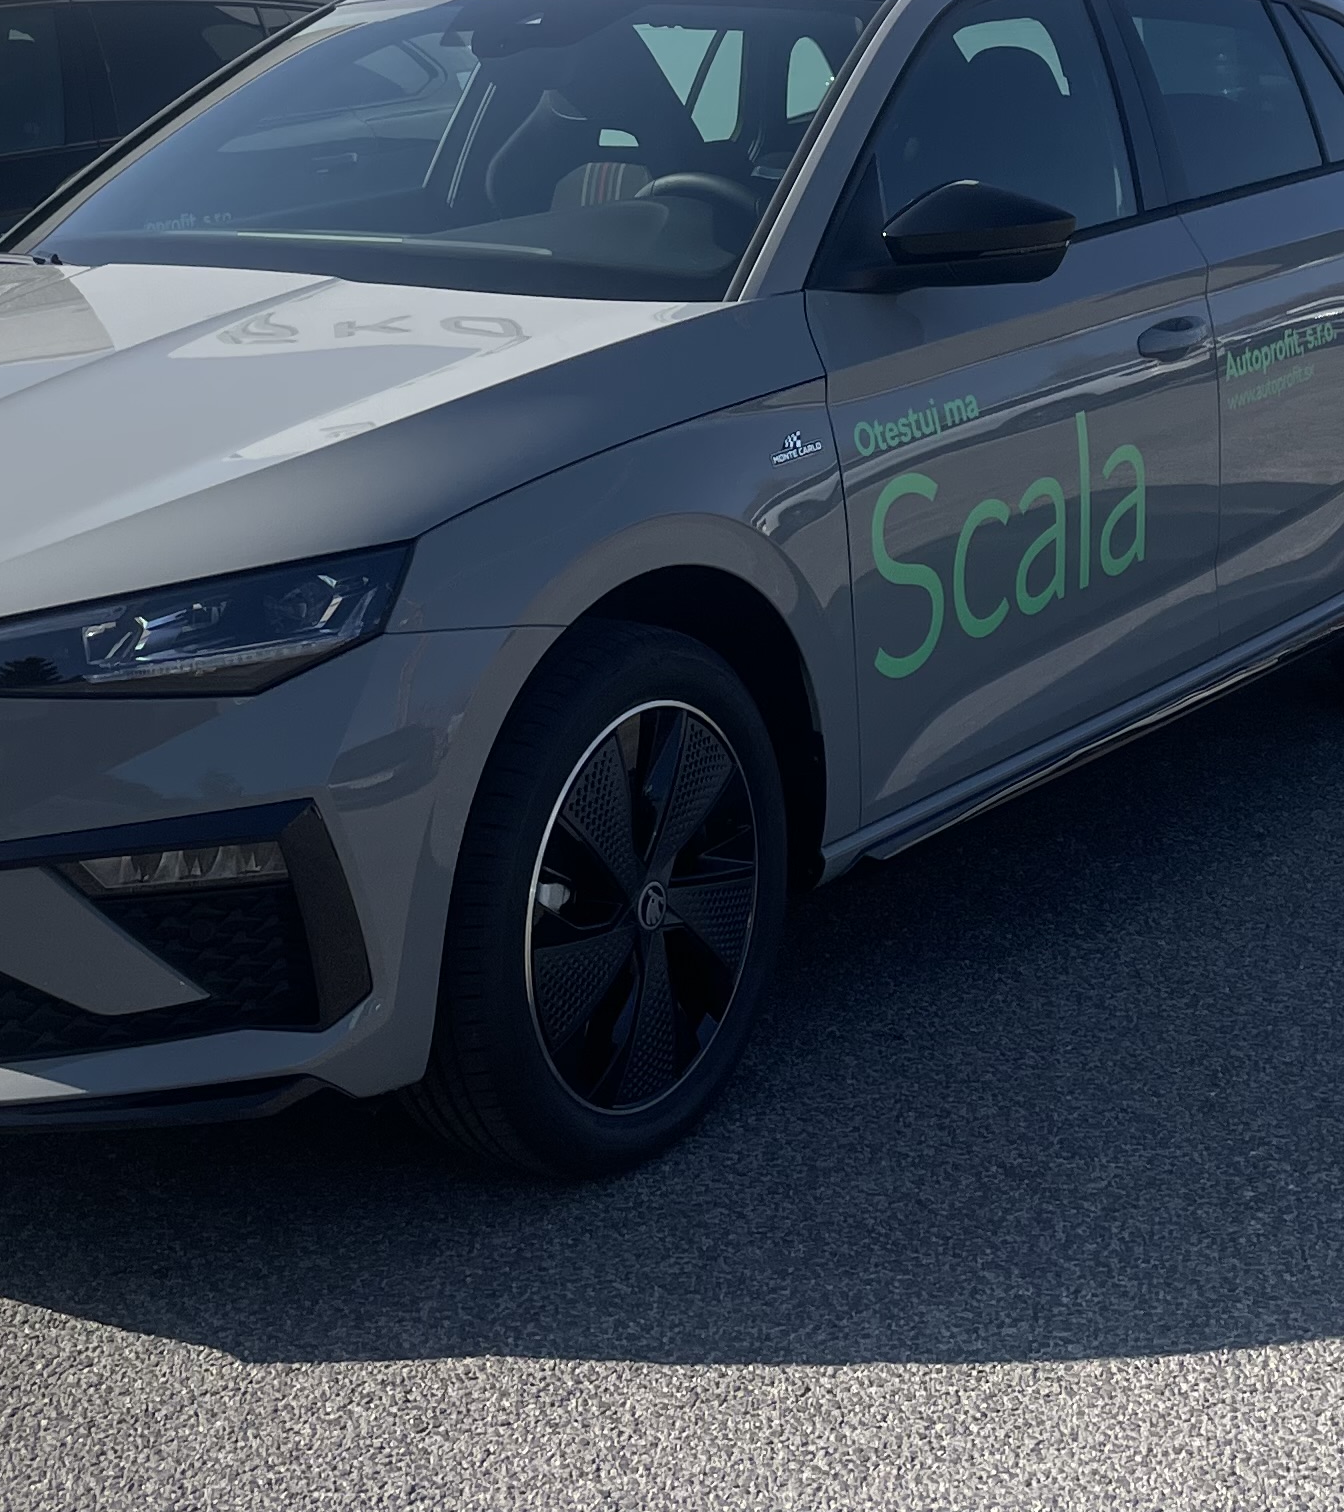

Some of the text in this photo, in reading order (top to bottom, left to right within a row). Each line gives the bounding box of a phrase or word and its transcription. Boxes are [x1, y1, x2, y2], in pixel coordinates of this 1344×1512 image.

[772, 441, 822, 464] MONTE CARLO
[854, 394, 979, 457] Otestuj ma
[872, 410, 1146, 678] Scala
